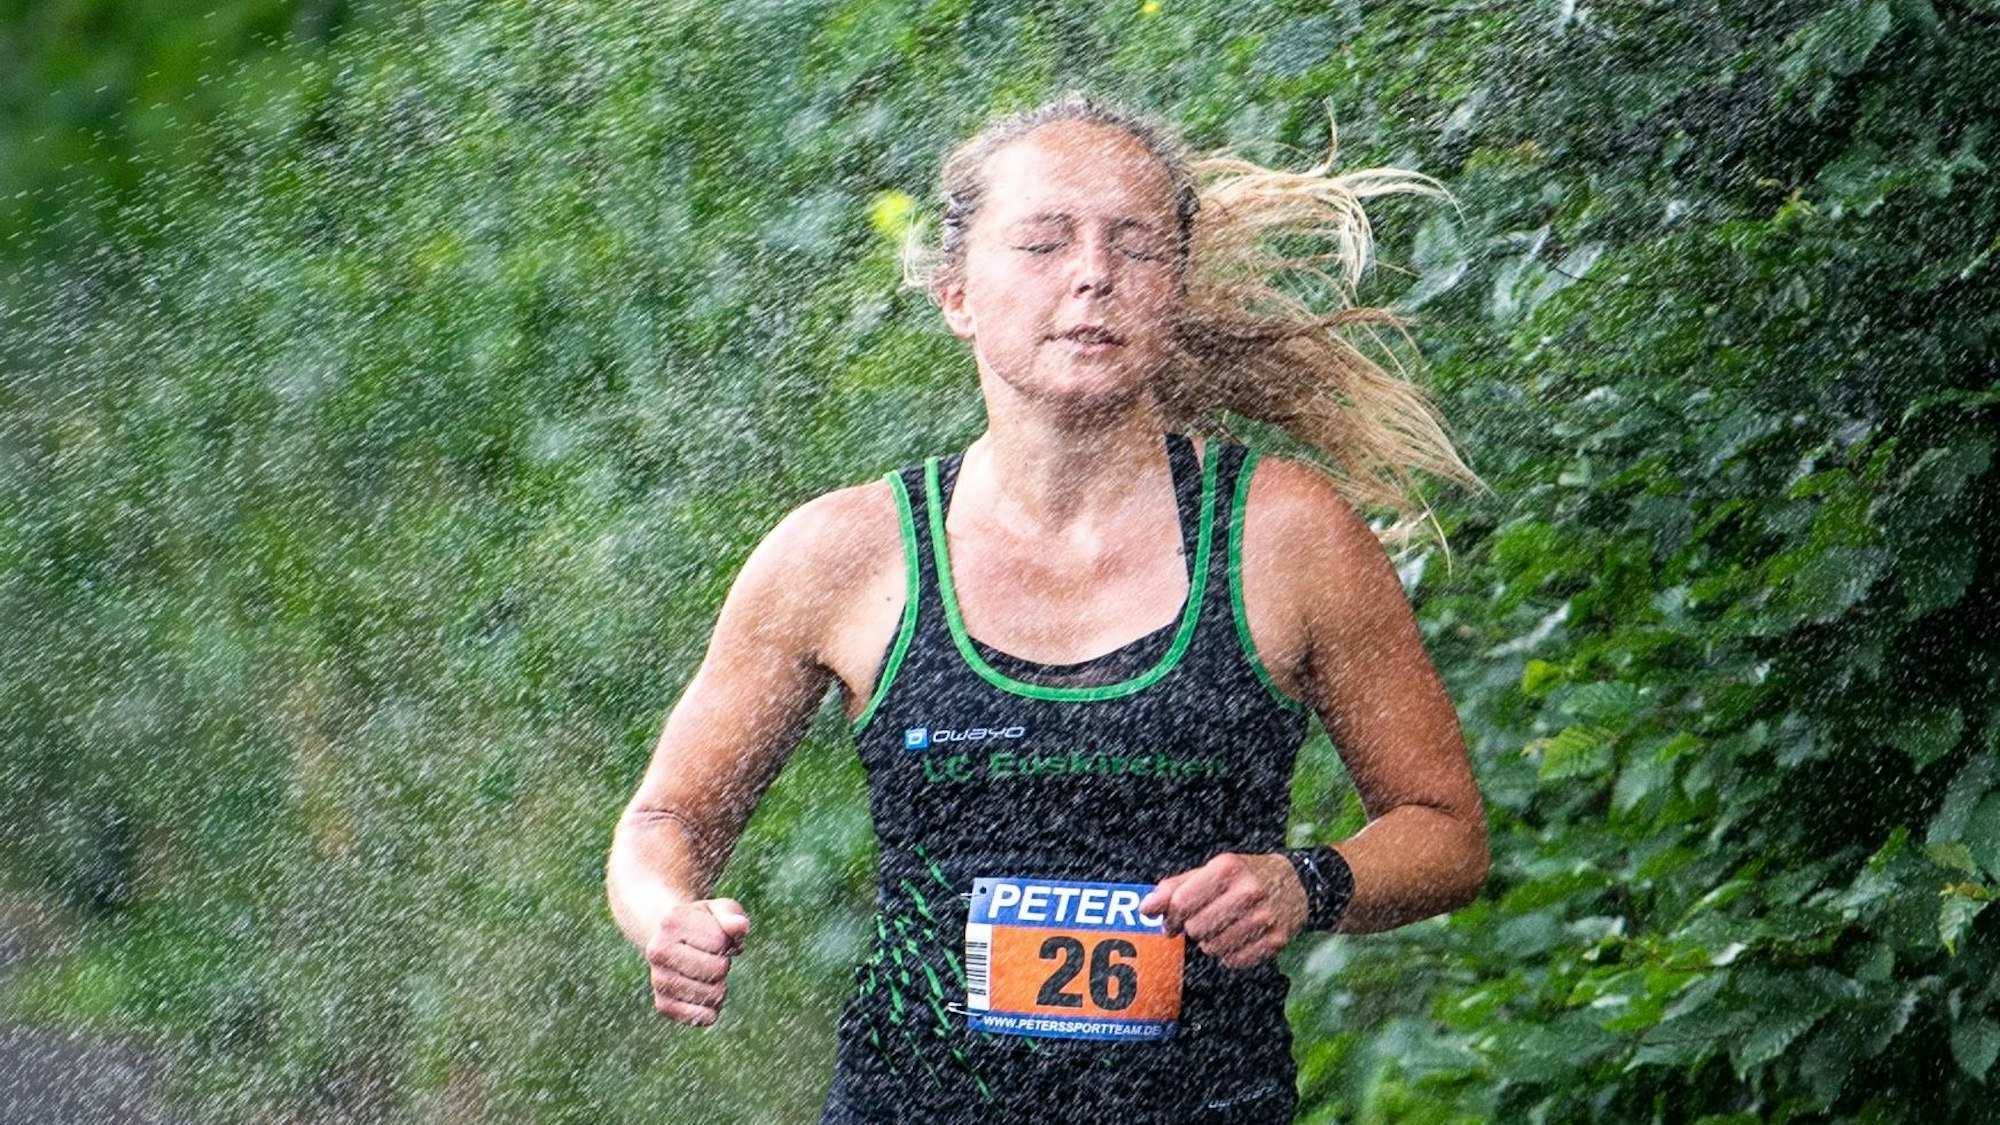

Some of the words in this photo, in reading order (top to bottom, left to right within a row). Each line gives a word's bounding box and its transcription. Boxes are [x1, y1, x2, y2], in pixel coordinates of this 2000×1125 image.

[923, 755, 972, 783] LC
[1036, 936, 1137, 1011] 26
[984, 1016, 1161, 1036] WWW.PETERSSPORTTEAM.DE
